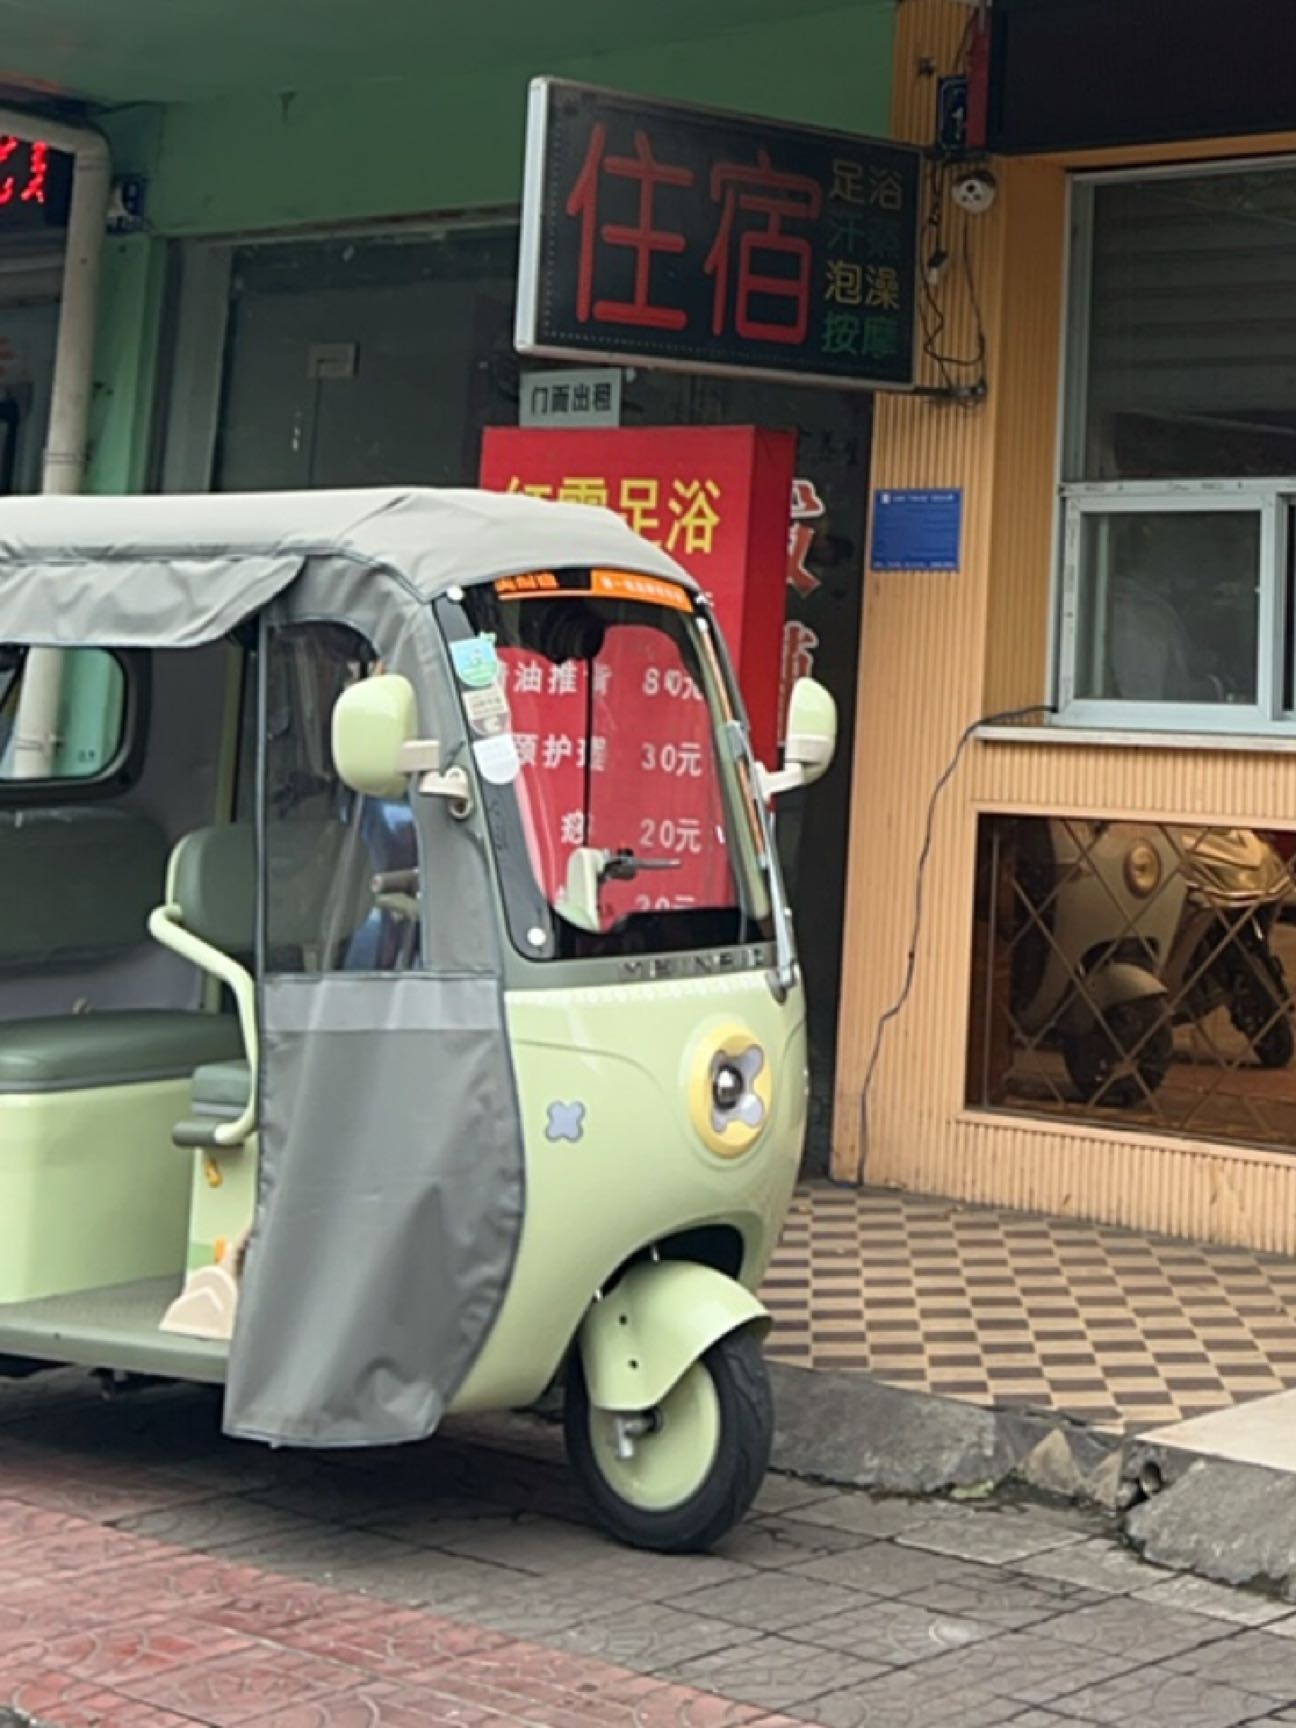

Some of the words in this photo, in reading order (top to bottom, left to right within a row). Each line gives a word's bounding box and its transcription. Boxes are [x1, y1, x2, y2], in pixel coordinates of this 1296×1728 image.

[829, 158, 903, 210] 足浴
[566, 121, 824, 345] 住宿
[825, 259, 900, 310] 泡澡
[531, 382, 612, 416] 门面出租
[641, 742, 703, 777] 30元
[639, 818, 701, 853] 20元
